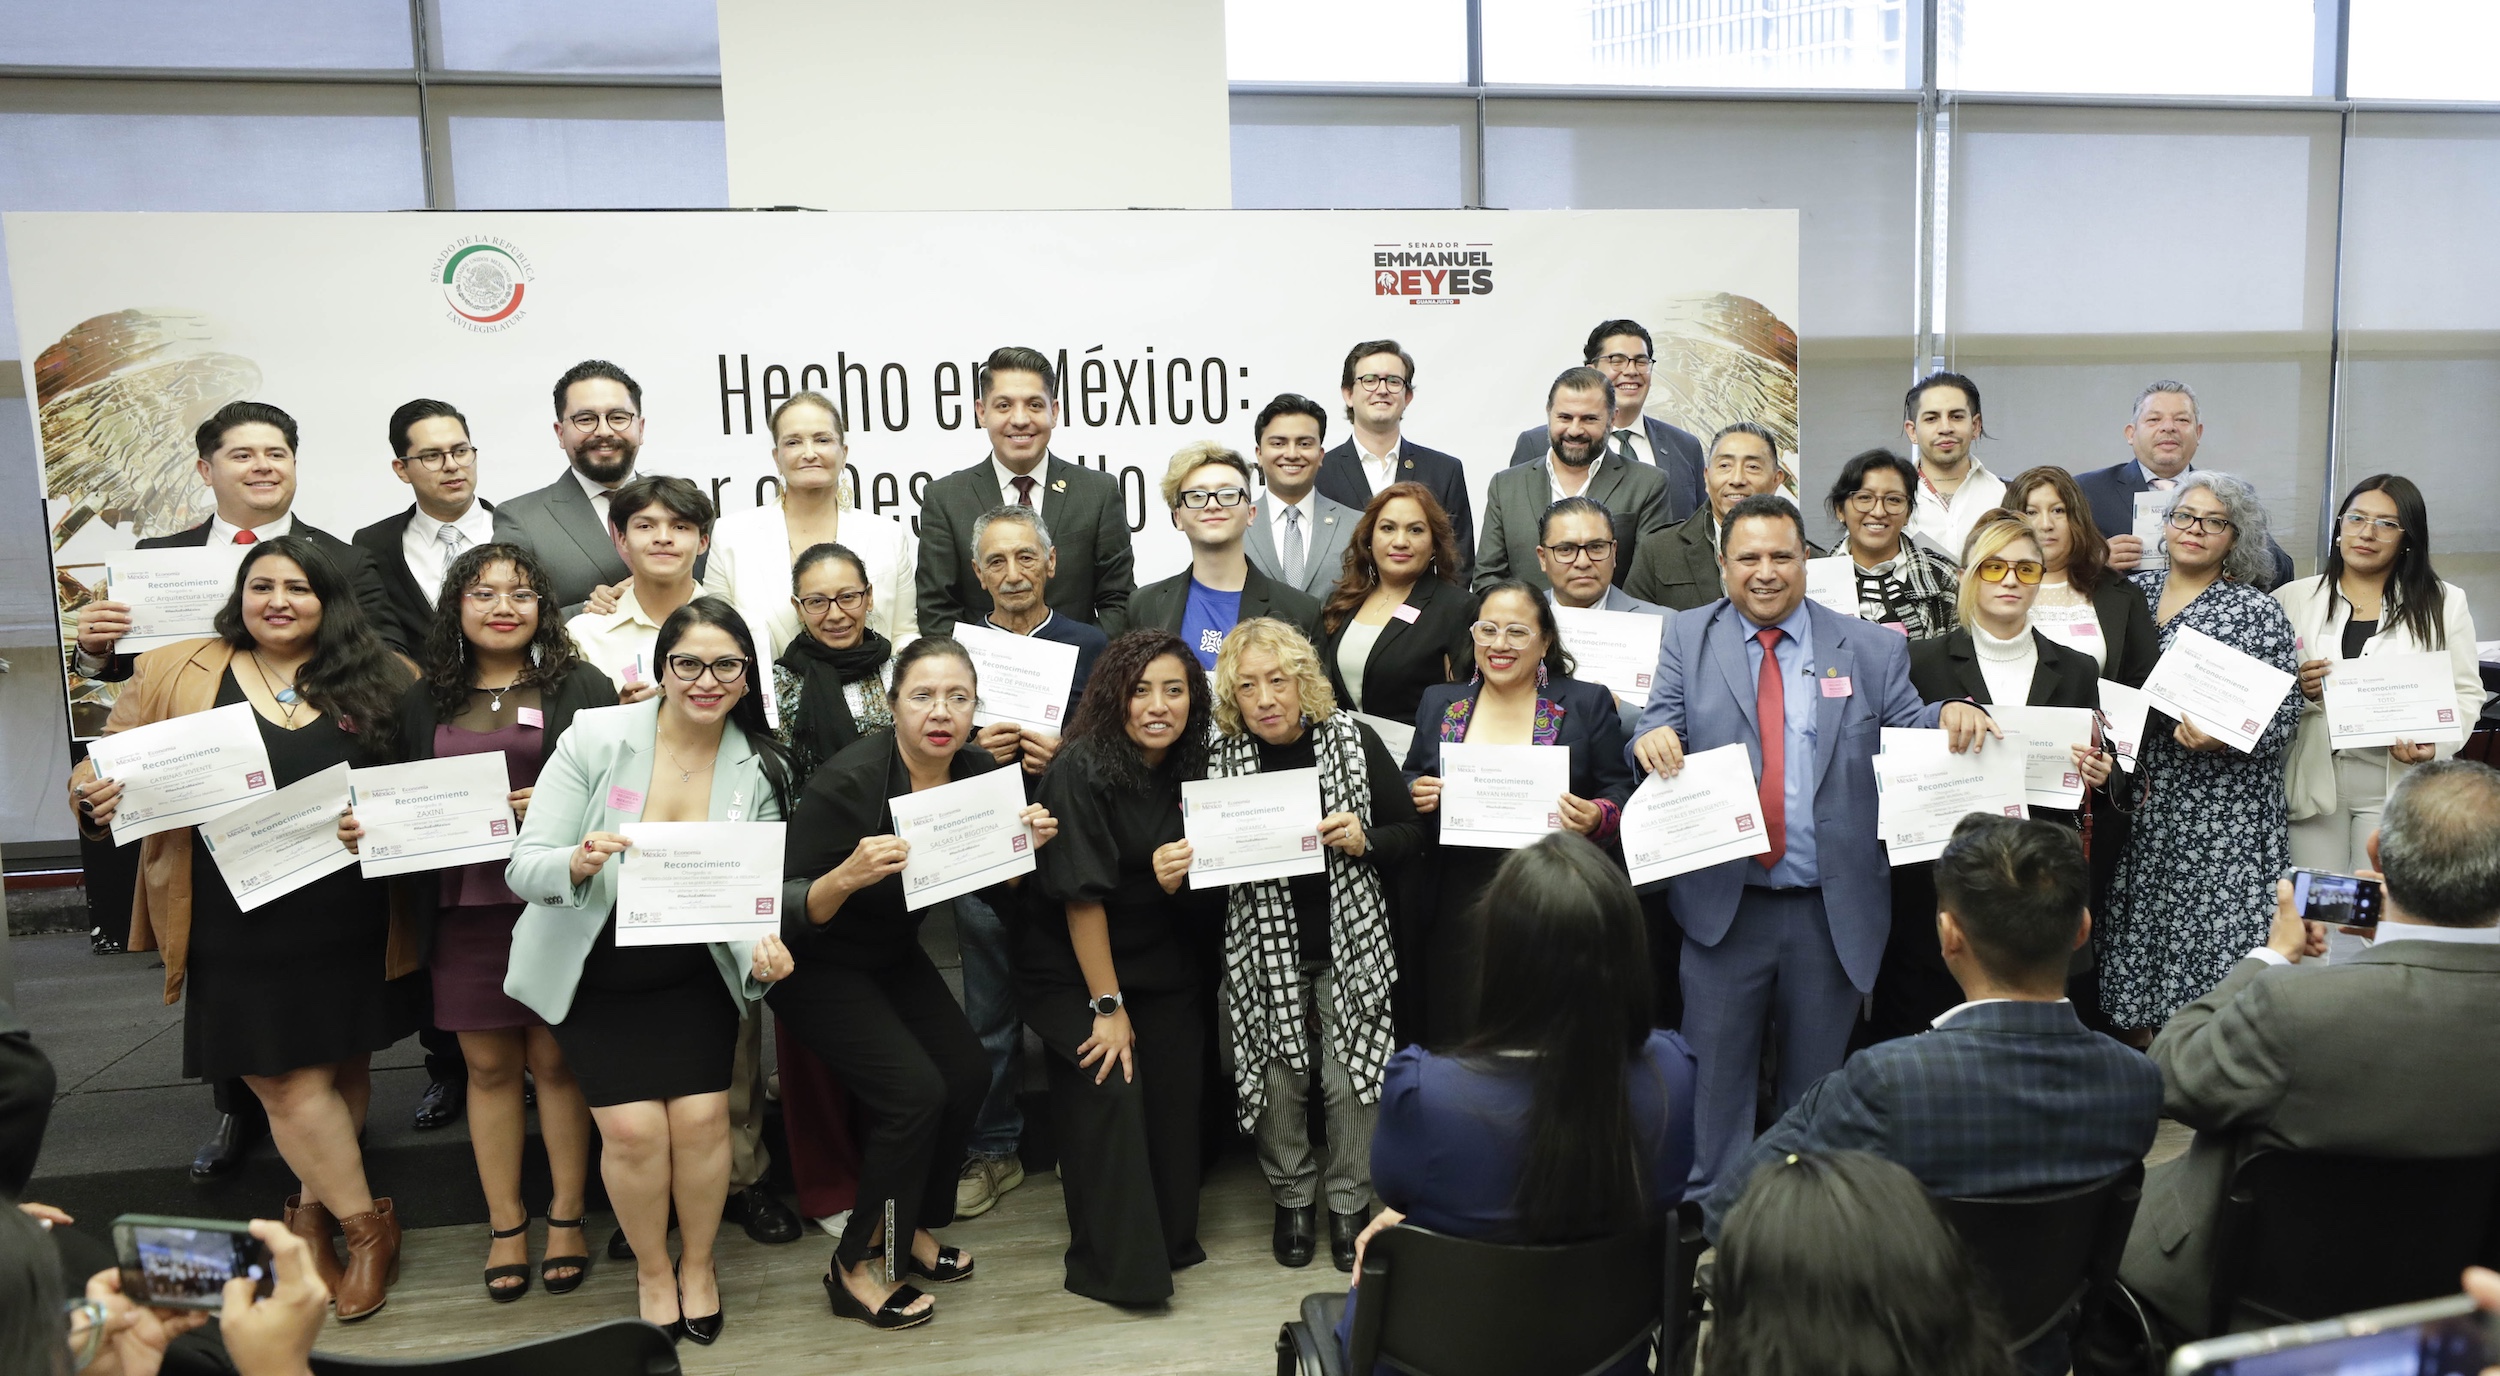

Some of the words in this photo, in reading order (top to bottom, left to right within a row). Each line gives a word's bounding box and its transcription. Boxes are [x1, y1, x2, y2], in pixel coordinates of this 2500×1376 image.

[430, 243, 456, 283] SENADO
[456, 235, 472, 247] DE
[474, 234, 489, 243] LA
[1374, 251, 1493, 267] EMMANUEL
[1375, 269, 1493, 295] REYES
[446, 311, 467, 329] LXVI
[468, 310, 527, 334] LEGISLATURA
[147, 578, 218, 589] Reconocimiento
[156, 592, 200, 603] Arquitectura
[202, 591, 224, 600] Ligera
[1569, 637, 1627, 647] Reconocimiento
[982, 659, 1041, 677] Reconocimiento
[986, 673, 1004, 683] FLOR
[1004, 677, 1013, 685] DE
[1013, 678, 1050, 693] PRIMAVERA
[2193, 662, 2250, 693] Reconocimiento
[2357, 682, 2418, 693] Reconocimiento
[141, 744, 221, 771] Reconocimiento
[2036, 753, 2064, 761] Figueroa
[149, 770, 183, 784] CATRINAS
[182, 762, 212, 775] VIVIENTE
[1474, 776, 1534, 785] Reconocimiento
[1917, 774, 1984, 792] Reconocimiento
[372, 789, 396, 798] México
[394, 788, 469, 806] Reconocimiento
[1647, 789, 1711, 812] Reconocimiento
[249, 802, 322, 838] Reconocimiento
[416, 807, 444, 818] ZAXINI
[931, 808, 995, 832] Reconocimiento
[1220, 805, 1285, 818] Reconocimiento
[1657, 810, 1688, 824] DIGITALES
[1687, 798, 1729, 815] INTELIGENTES
[241, 837, 275, 855] QUERREQUE
[274, 824, 305, 841] ARTESANAL
[929, 836, 955, 849] SALSAS
[954, 833, 963, 841] LA
[963, 822, 1000, 838] BIGOTONA
[663, 859, 740, 869] Reconocimiento
